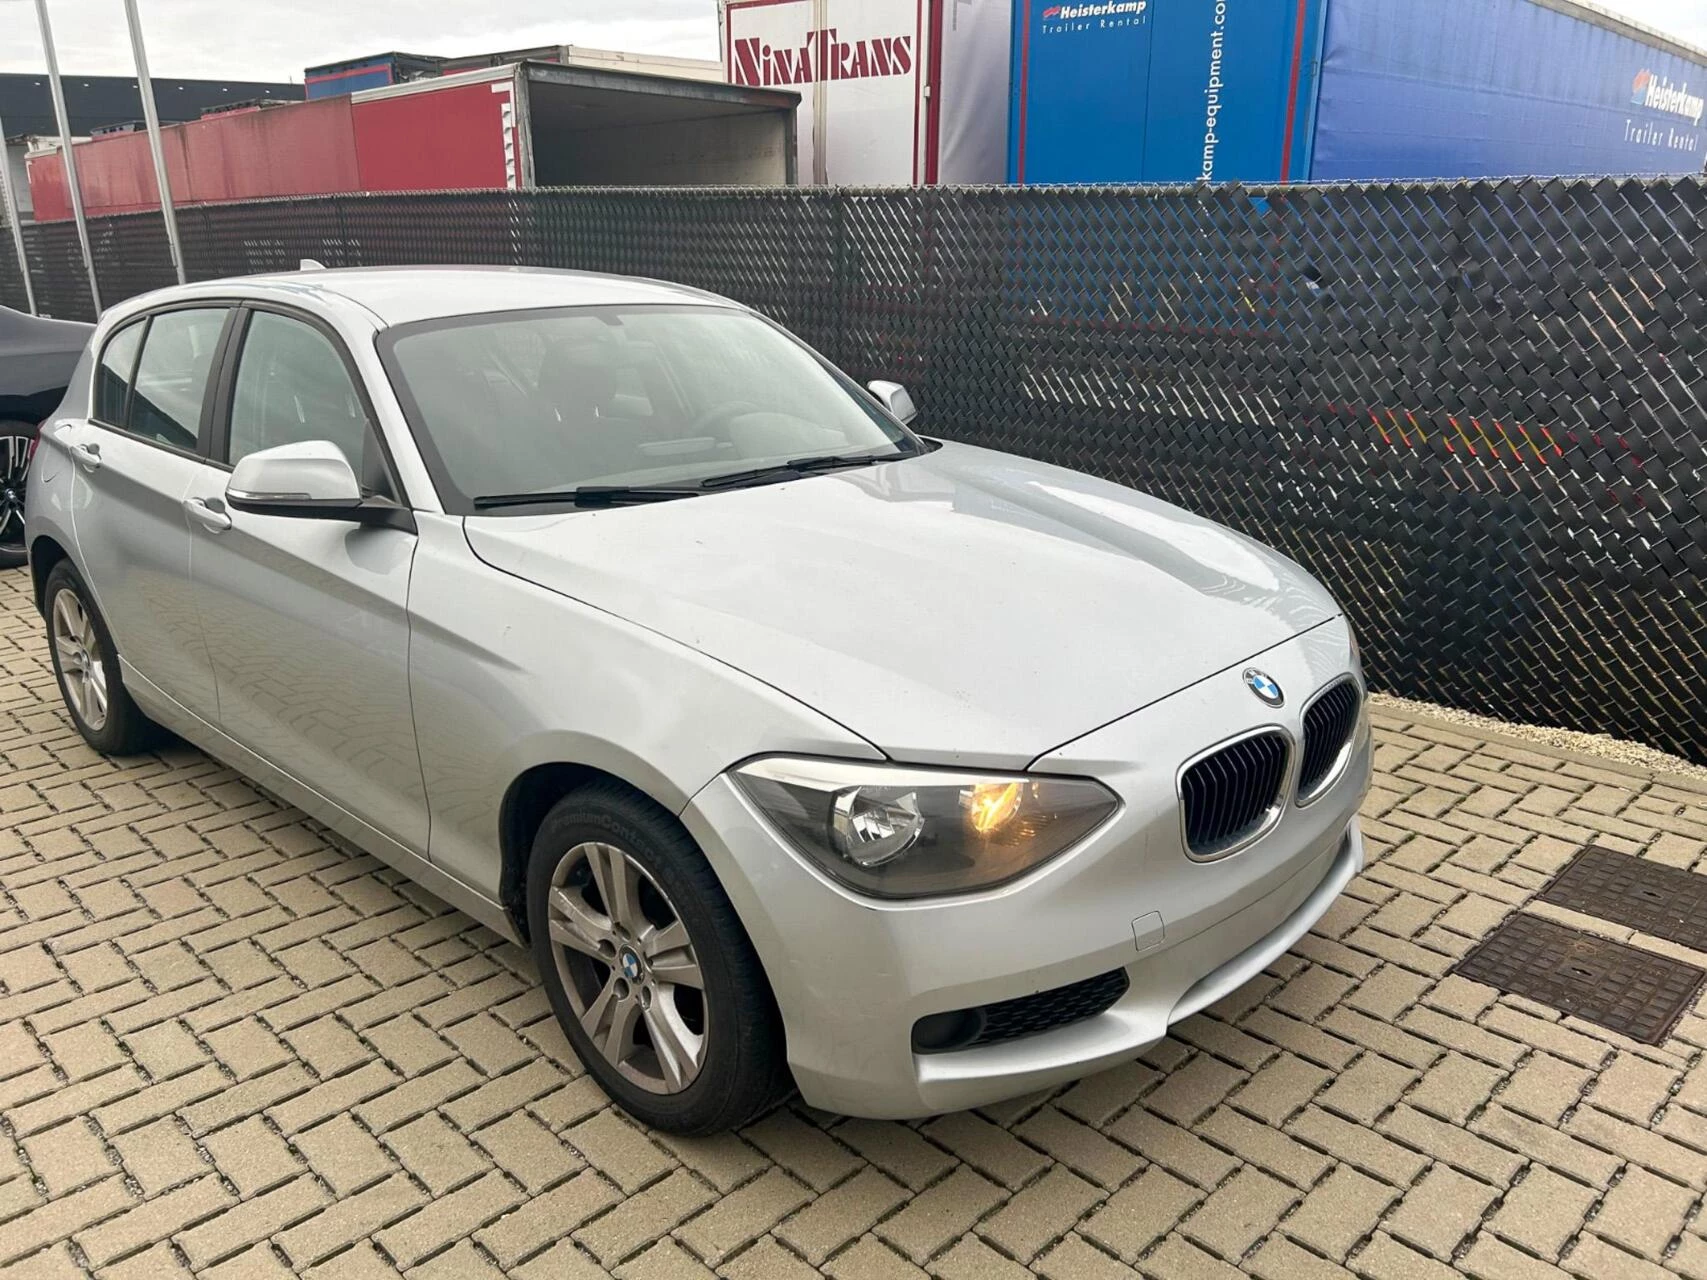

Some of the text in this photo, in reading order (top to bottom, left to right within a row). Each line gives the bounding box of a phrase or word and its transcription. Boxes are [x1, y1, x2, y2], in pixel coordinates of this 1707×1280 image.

[1060, 0, 1147, 19] Heisterkamp
[1042, 15, 1147, 34] Trailer Rental
[1196, 0, 1226, 182] kamp-equipment.co
[1644, 73, 1704, 127] Heisterkamp
[1624, 119, 1663, 147] Trailer
